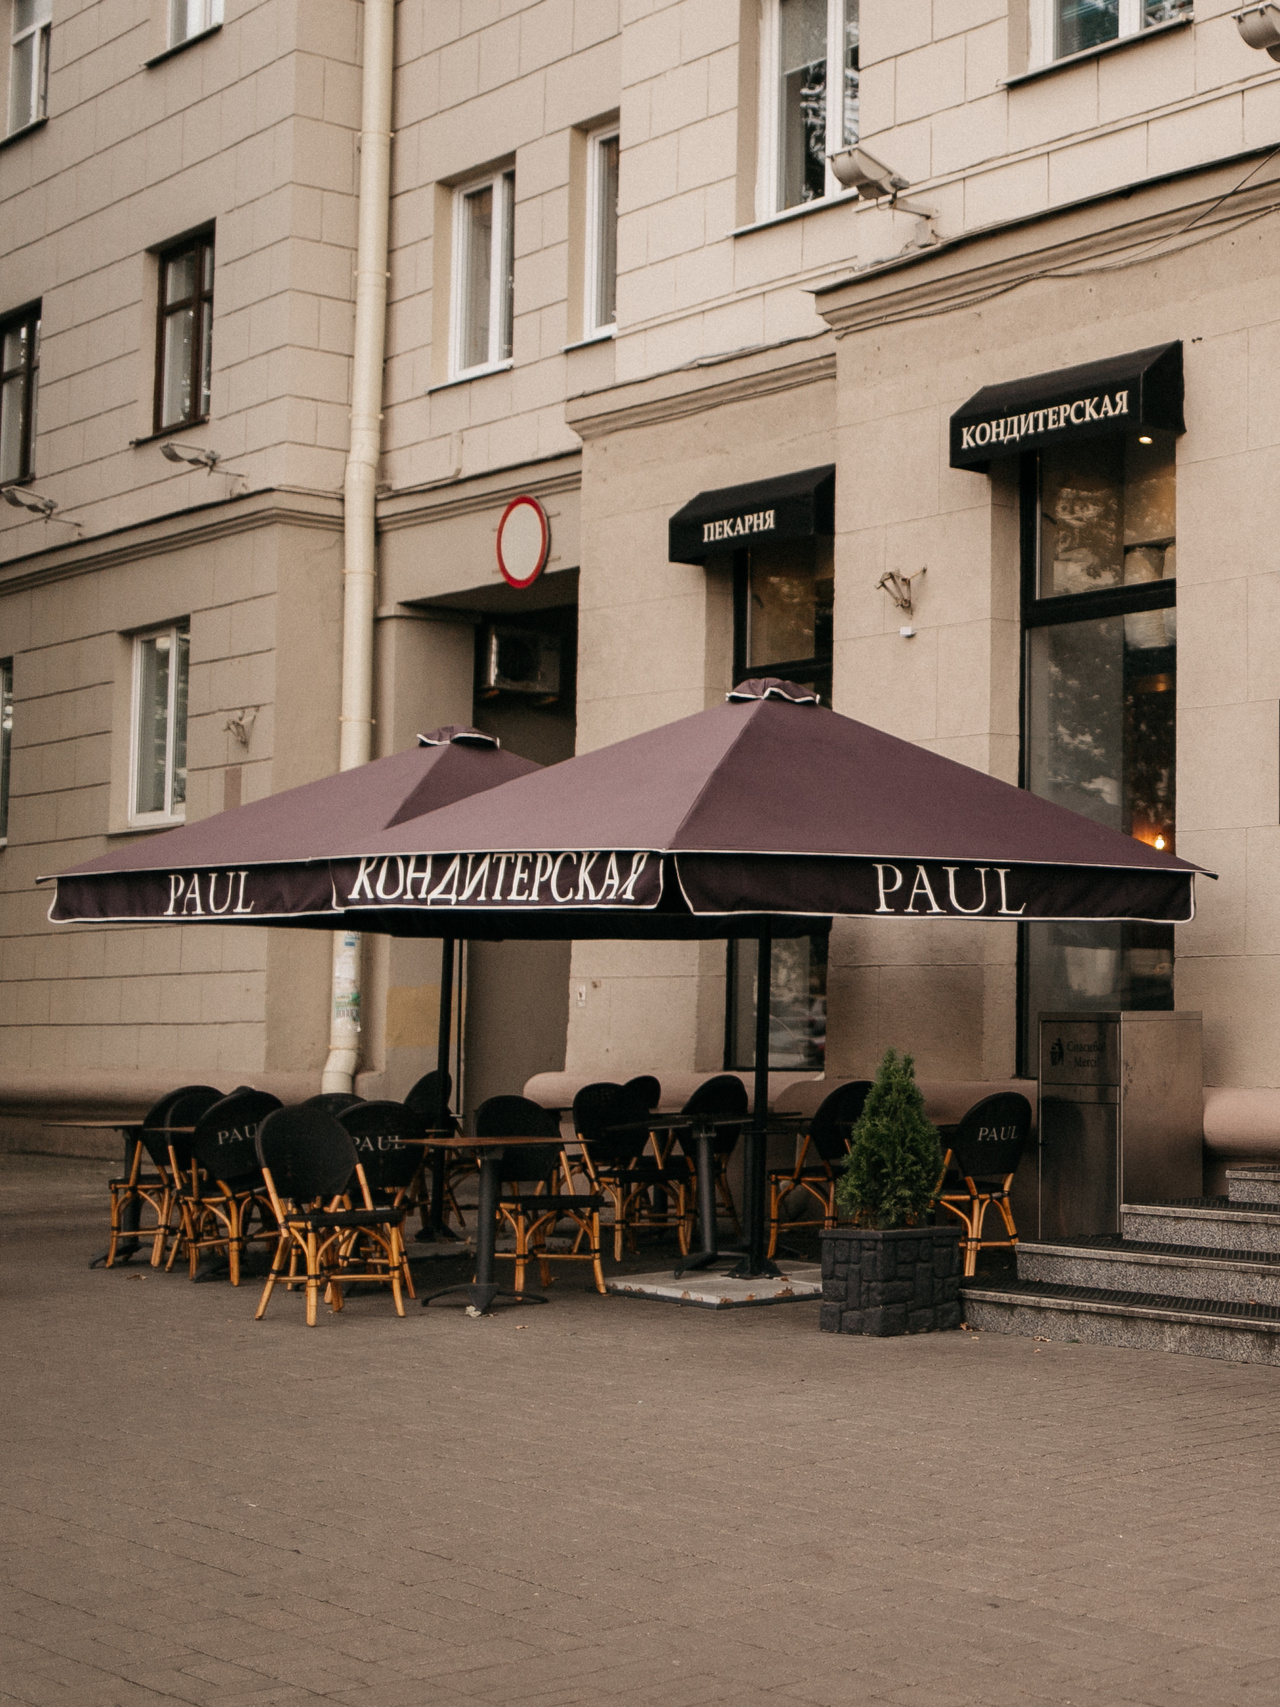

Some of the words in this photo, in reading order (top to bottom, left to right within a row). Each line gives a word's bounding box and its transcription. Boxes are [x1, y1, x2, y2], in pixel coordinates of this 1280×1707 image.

[961, 390, 1129, 449] КОНДИТЕРСКАЯ
[702, 509, 775, 542] ПЕКАРНЯ
[163, 871, 255, 915] PAUL
[348, 852, 650, 906] КОНДИТЕРСКАЯ
[872, 863, 1026, 914] PAUL
[217, 1123, 257, 1145] PAU
[977, 1125, 1018, 1141] PAUL
